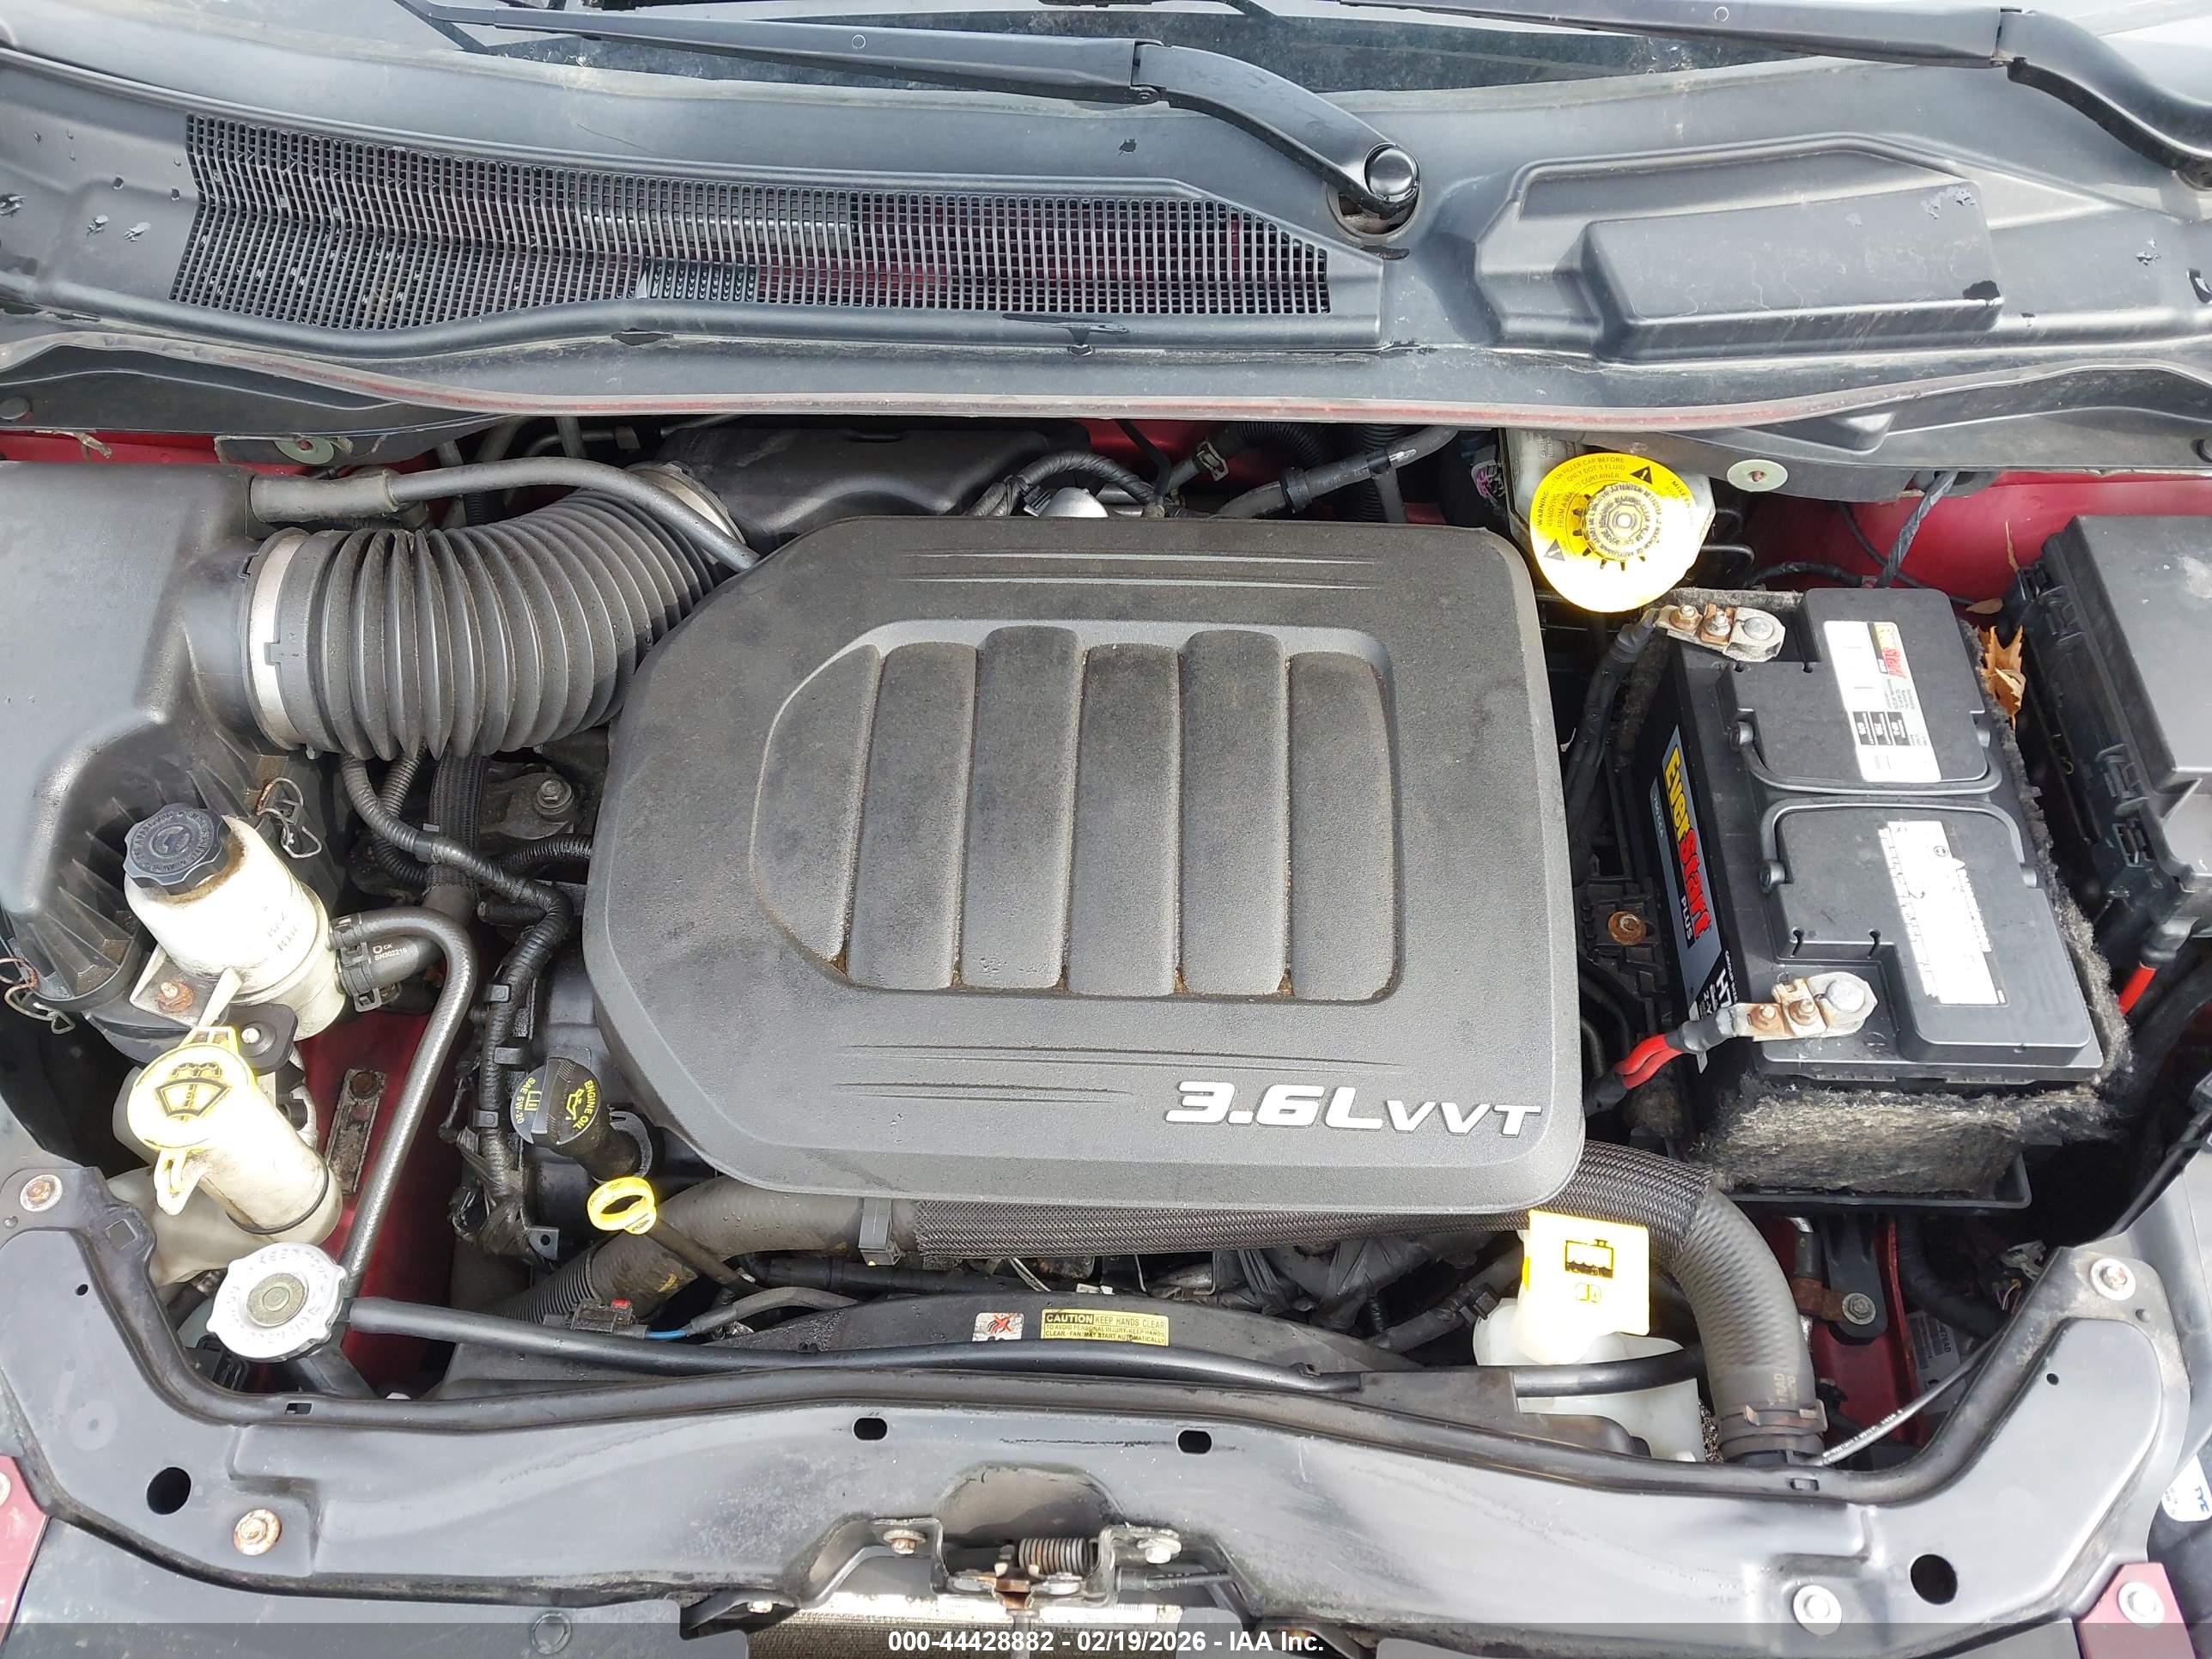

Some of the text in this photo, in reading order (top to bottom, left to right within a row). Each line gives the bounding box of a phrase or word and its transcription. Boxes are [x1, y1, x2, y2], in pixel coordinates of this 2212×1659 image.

[1566, 470, 1583, 482] ONLY
[1583, 465, 1595, 474] DOT
[1605, 463, 1626, 471] FLUID
[1583, 458, 1595, 466] CAP
[1680, 894, 1693, 941] PLUS
[1716, 968, 1732, 1008] H7
[514, 1077, 536, 1124] SAE 5W-20
[572, 1079, 596, 1130] ENGINE OIL
[1164, 1079, 1543, 1139] 3.6L VVT
[1046, 1314, 1164, 1329] CAUTION KEEP HANDS CLEAR
[1117, 1334, 1165, 1344] AUTOMATICALLY
